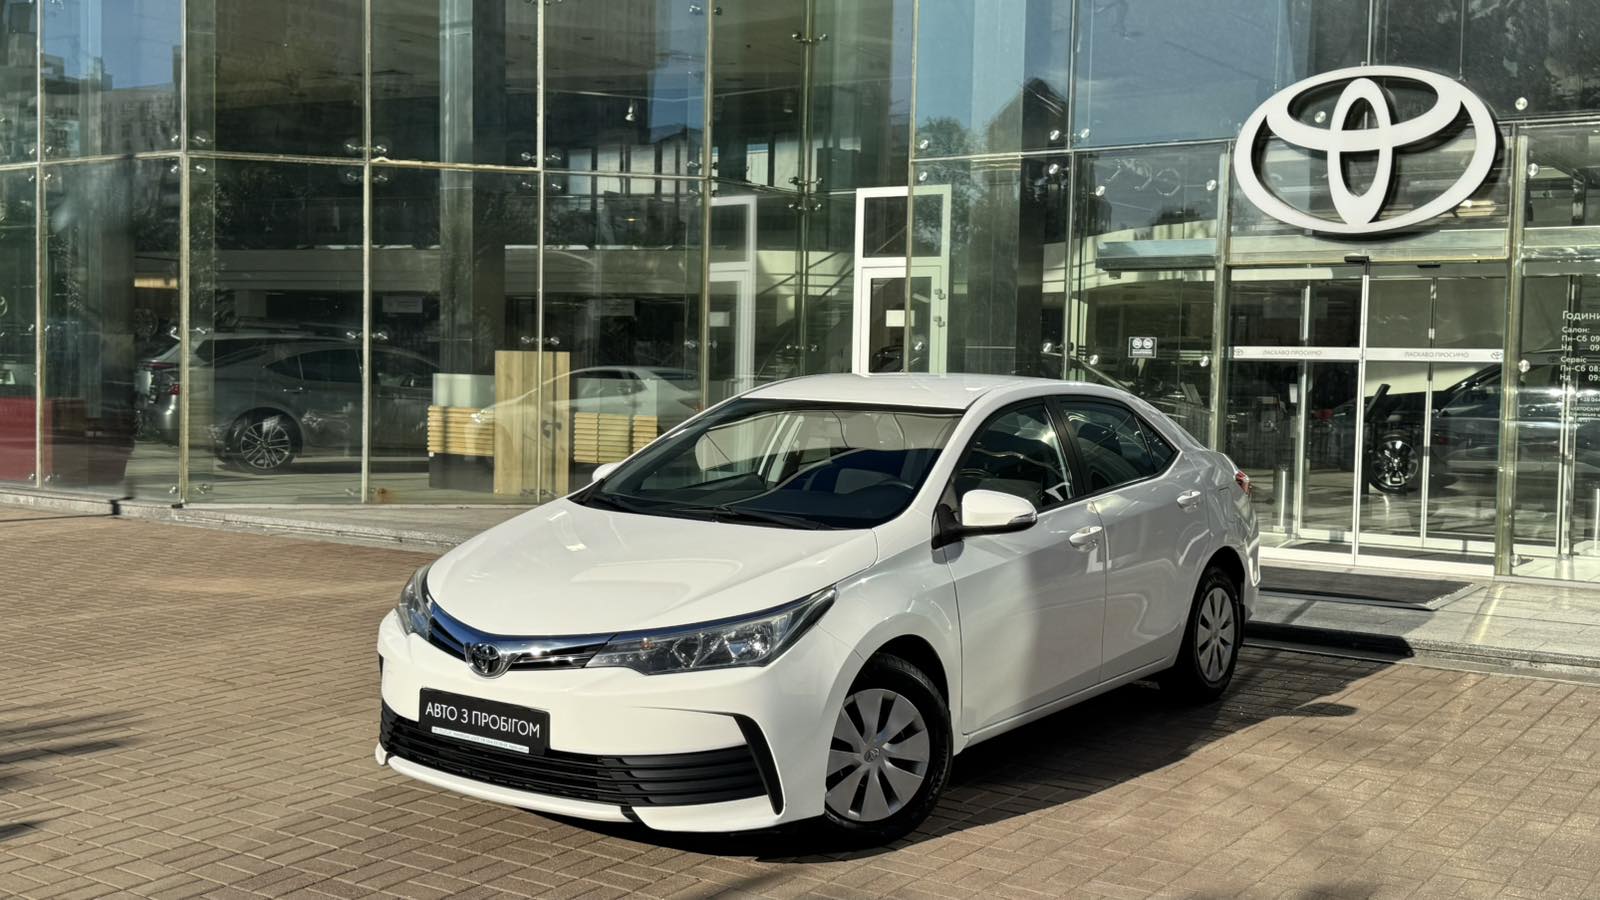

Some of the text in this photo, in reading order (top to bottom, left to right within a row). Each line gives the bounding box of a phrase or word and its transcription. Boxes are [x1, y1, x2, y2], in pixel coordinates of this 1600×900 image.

[1561, 326, 1590, 334] Салон:
[1561, 334, 1588, 343] Пн-Сб
[1561, 343, 1573, 352] Нд
[1560, 364, 1586, 372] Пн-Сб
[1559, 374, 1571, 382] Нд
[425, 701, 458, 721] АВТО
[471, 710, 540, 739] ПРОБІГОМ
